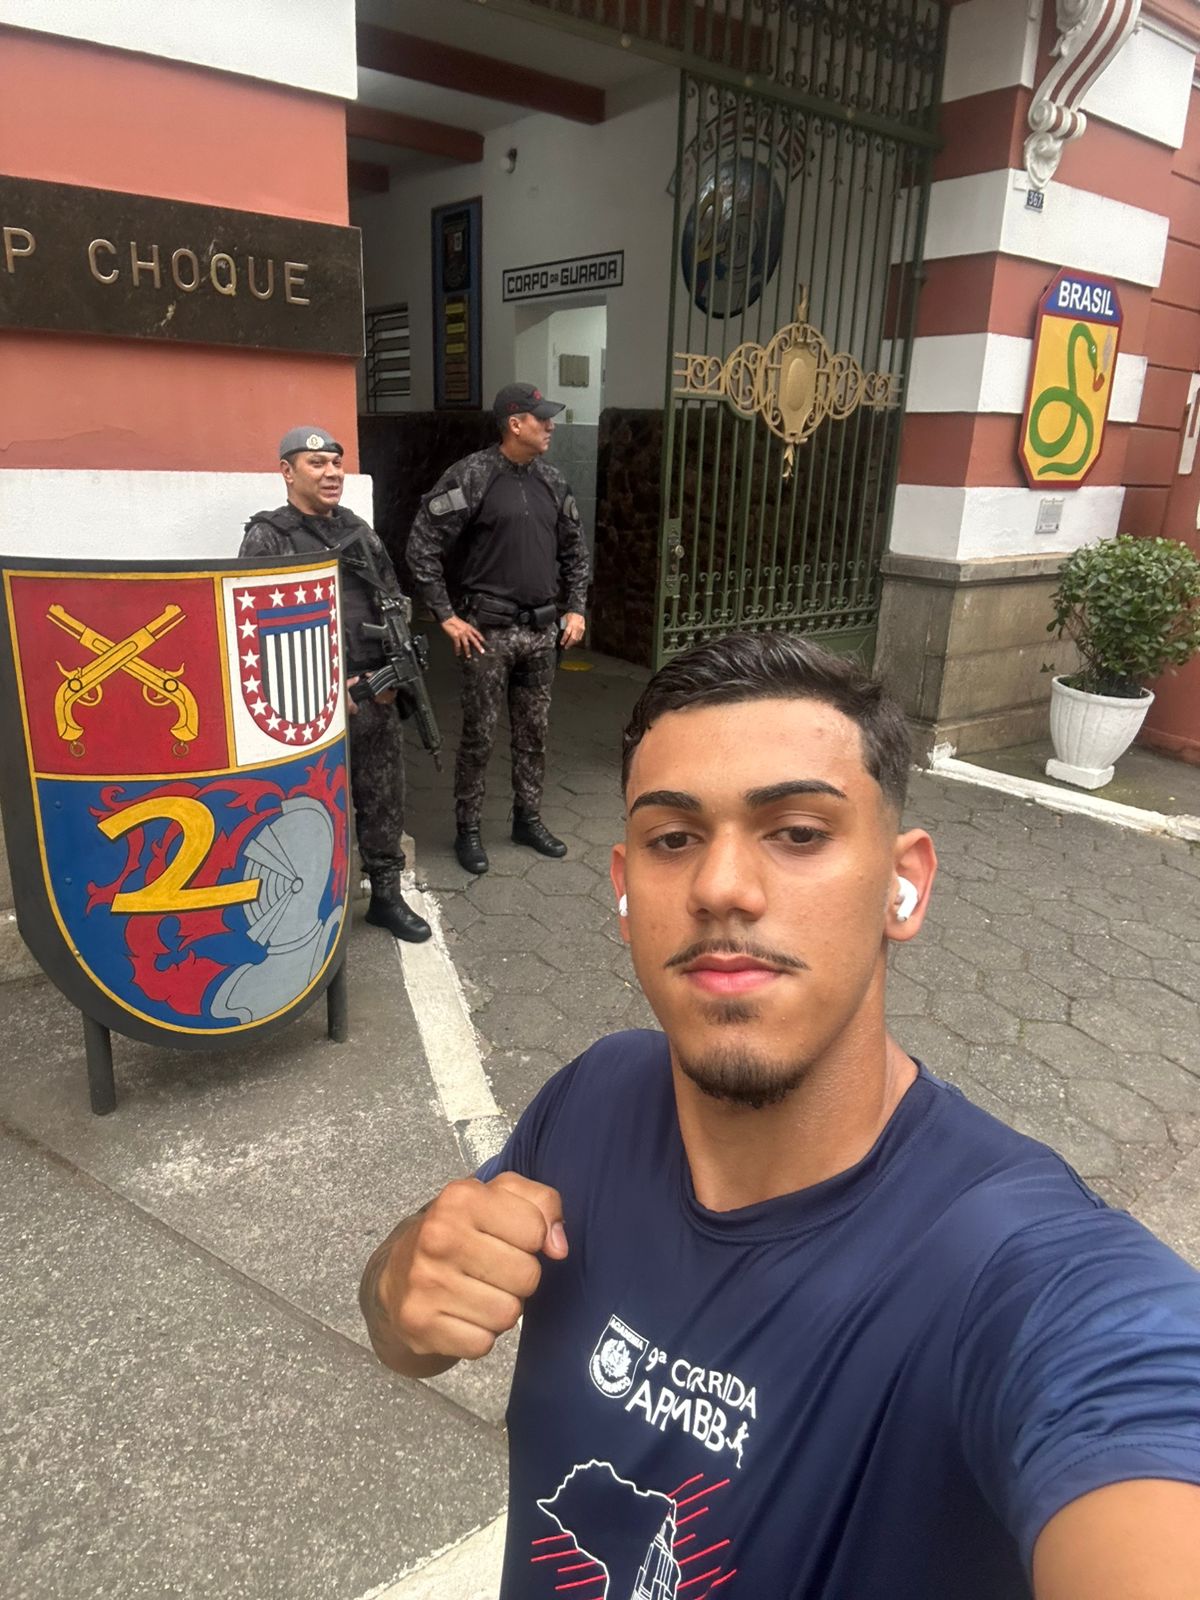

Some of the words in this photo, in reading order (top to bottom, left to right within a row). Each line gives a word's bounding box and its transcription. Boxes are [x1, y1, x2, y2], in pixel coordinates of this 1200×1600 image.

[3, 227, 36, 273] P
[88, 239, 310, 305] CHOQUE
[507, 271, 548, 293] CORPO
[560, 260, 617, 285] GUARDA
[1058, 280, 1114, 316] BRASIL
[97, 795, 263, 914] 2
